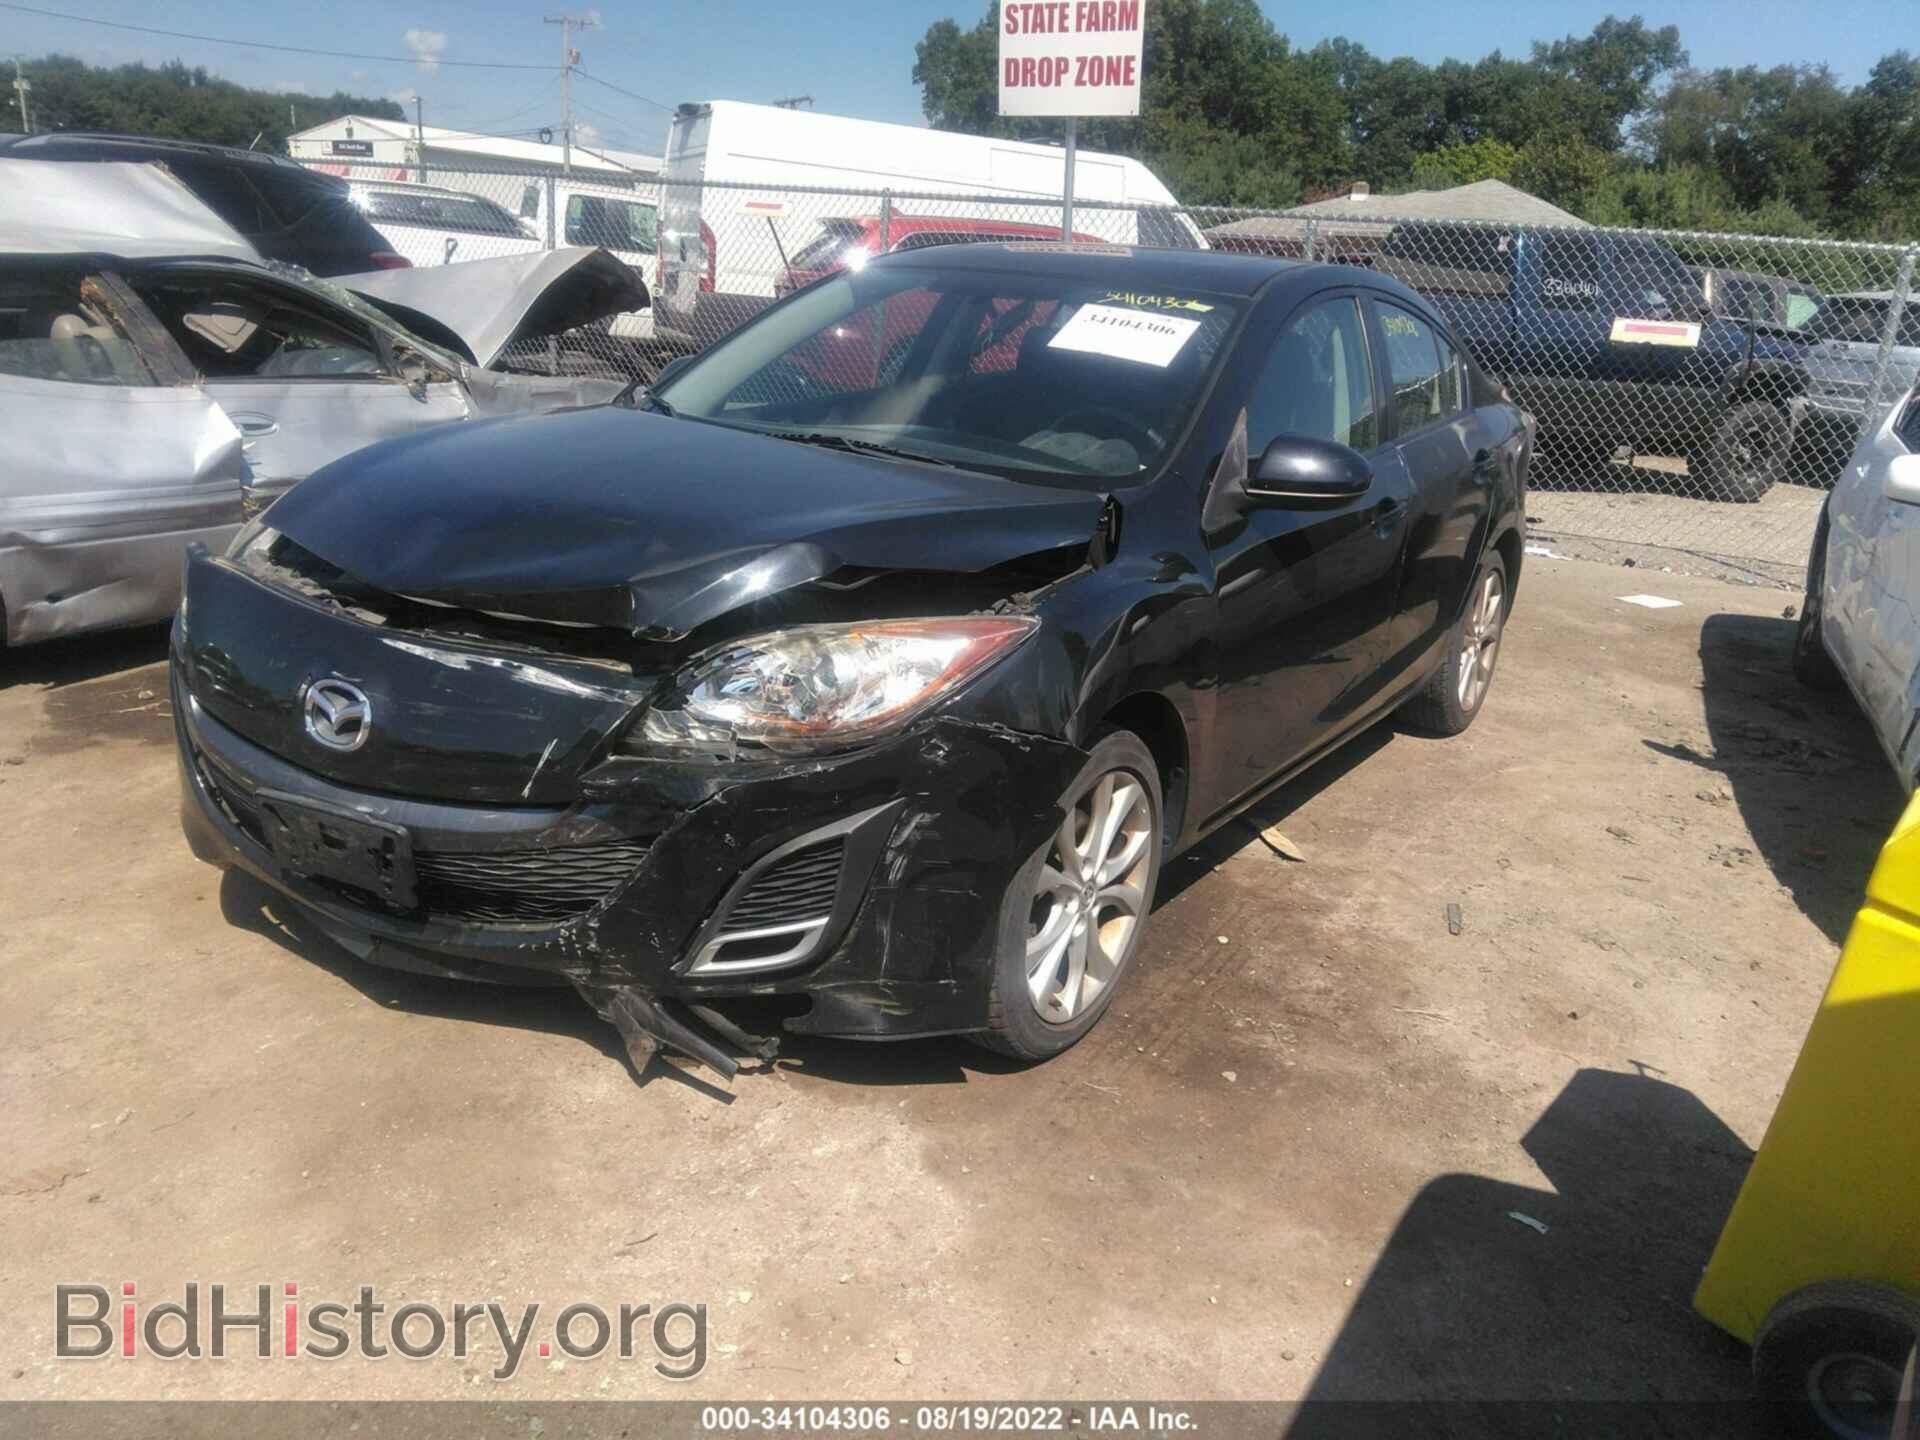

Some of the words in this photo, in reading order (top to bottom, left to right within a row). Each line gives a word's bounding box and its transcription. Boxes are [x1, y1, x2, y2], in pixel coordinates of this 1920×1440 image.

[1005, 3, 1069, 35] STATE
[1075, 1, 1138, 32] FARM
[1005, 57, 1069, 88] DROP
[1075, 55, 1136, 87] ZONE
